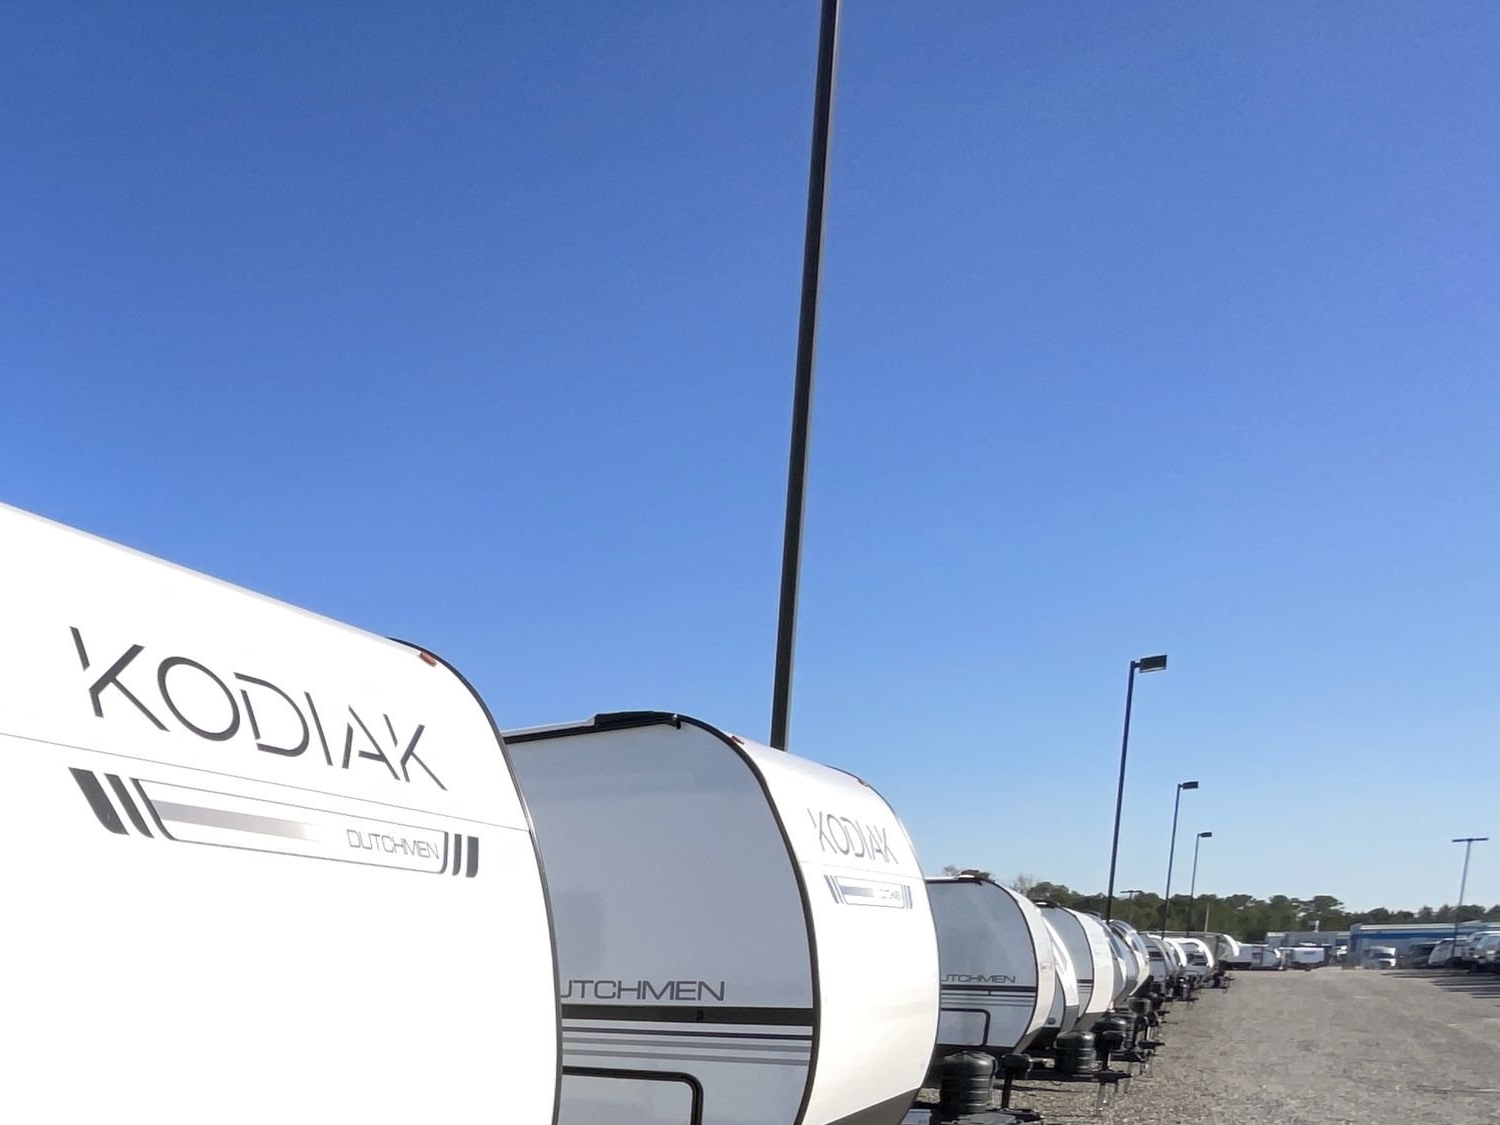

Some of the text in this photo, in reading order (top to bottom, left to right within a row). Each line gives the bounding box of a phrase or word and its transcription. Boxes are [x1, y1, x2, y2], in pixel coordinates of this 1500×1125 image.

[69, 626, 448, 791] KODIAK
[346, 829, 440, 859] DUTCHMEN
[807, 808, 899, 864] KODIAK
[561, 980, 725, 1001] UTCHMEN
[941, 974, 1016, 984] UTCHMEN
